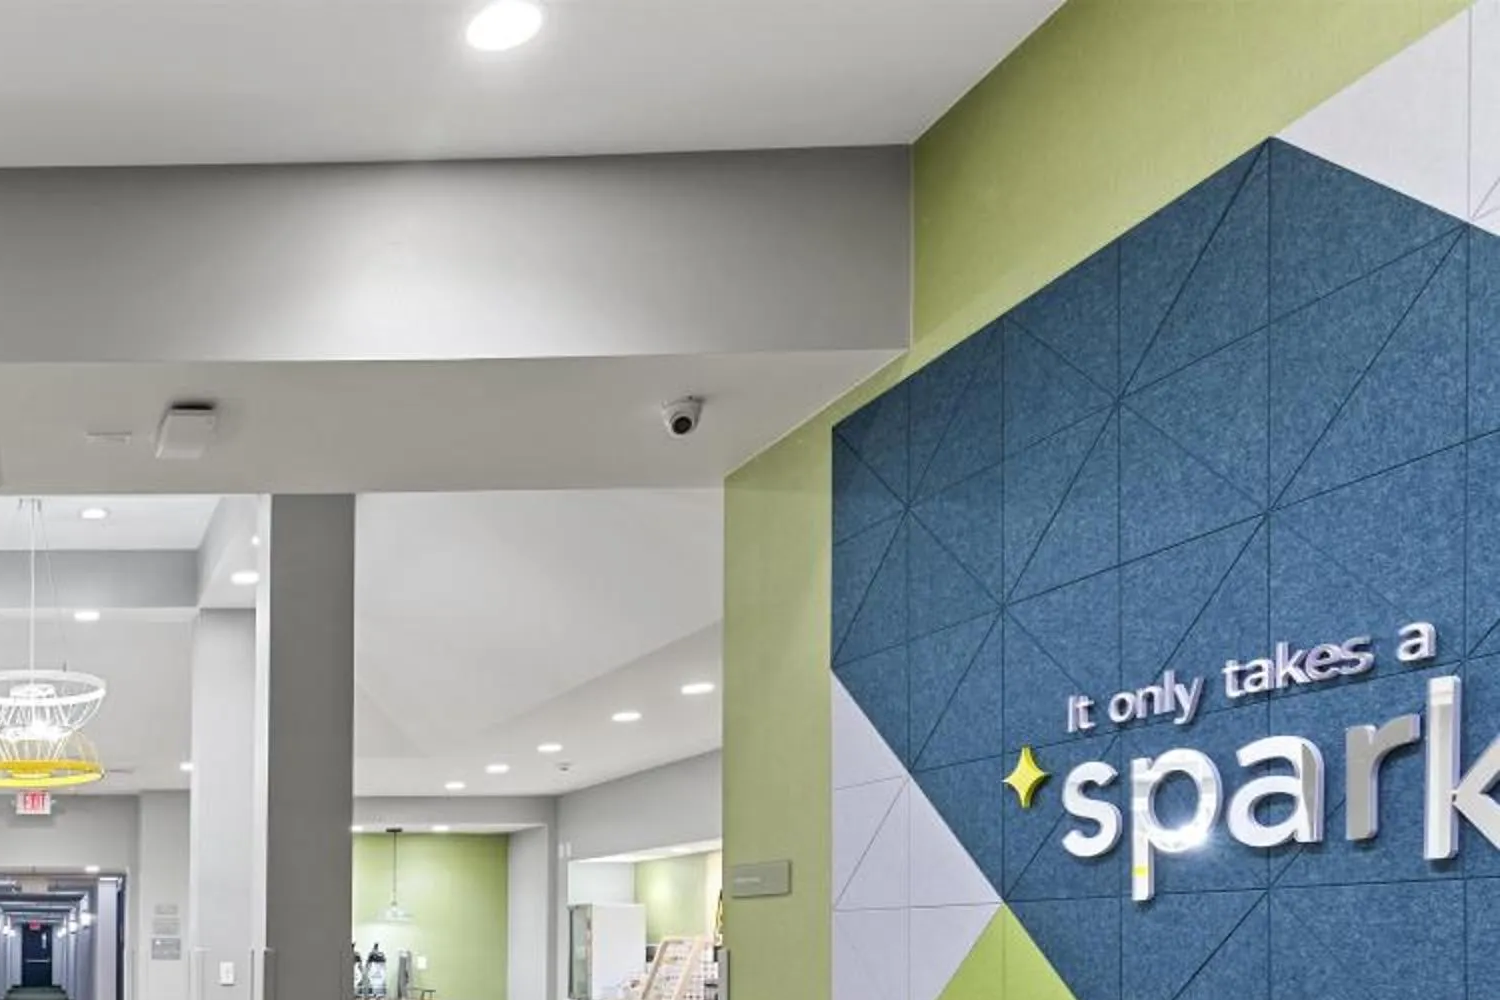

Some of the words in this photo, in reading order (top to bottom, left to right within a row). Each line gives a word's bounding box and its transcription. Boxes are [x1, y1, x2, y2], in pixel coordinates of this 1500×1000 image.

[1067, 695, 1095, 733] It
[1108, 670, 1205, 725] only
[1222, 635, 1375, 699] takes
[1396, 621, 1437, 662] a
[1061, 675, 1500, 901] spark
